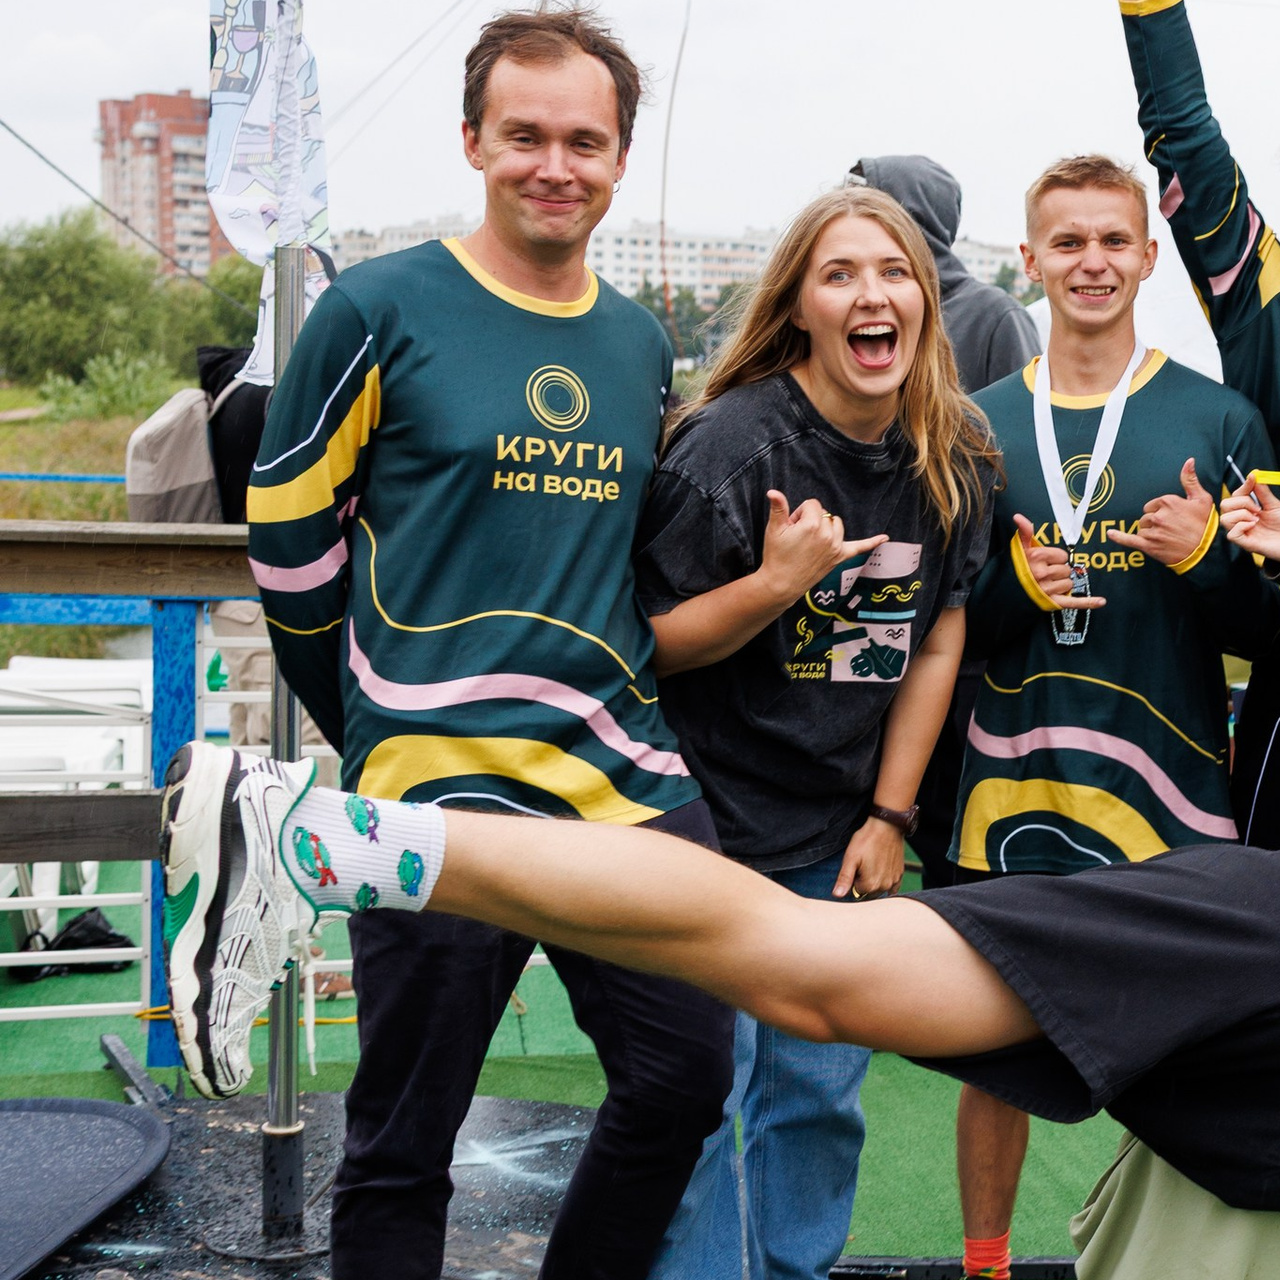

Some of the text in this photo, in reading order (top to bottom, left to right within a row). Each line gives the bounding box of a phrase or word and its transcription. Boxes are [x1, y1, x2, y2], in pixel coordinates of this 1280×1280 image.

[496, 434, 623, 473] КРУГИ
[493, 470, 620, 503] на воде
[1074, 550, 1145, 572] воде
